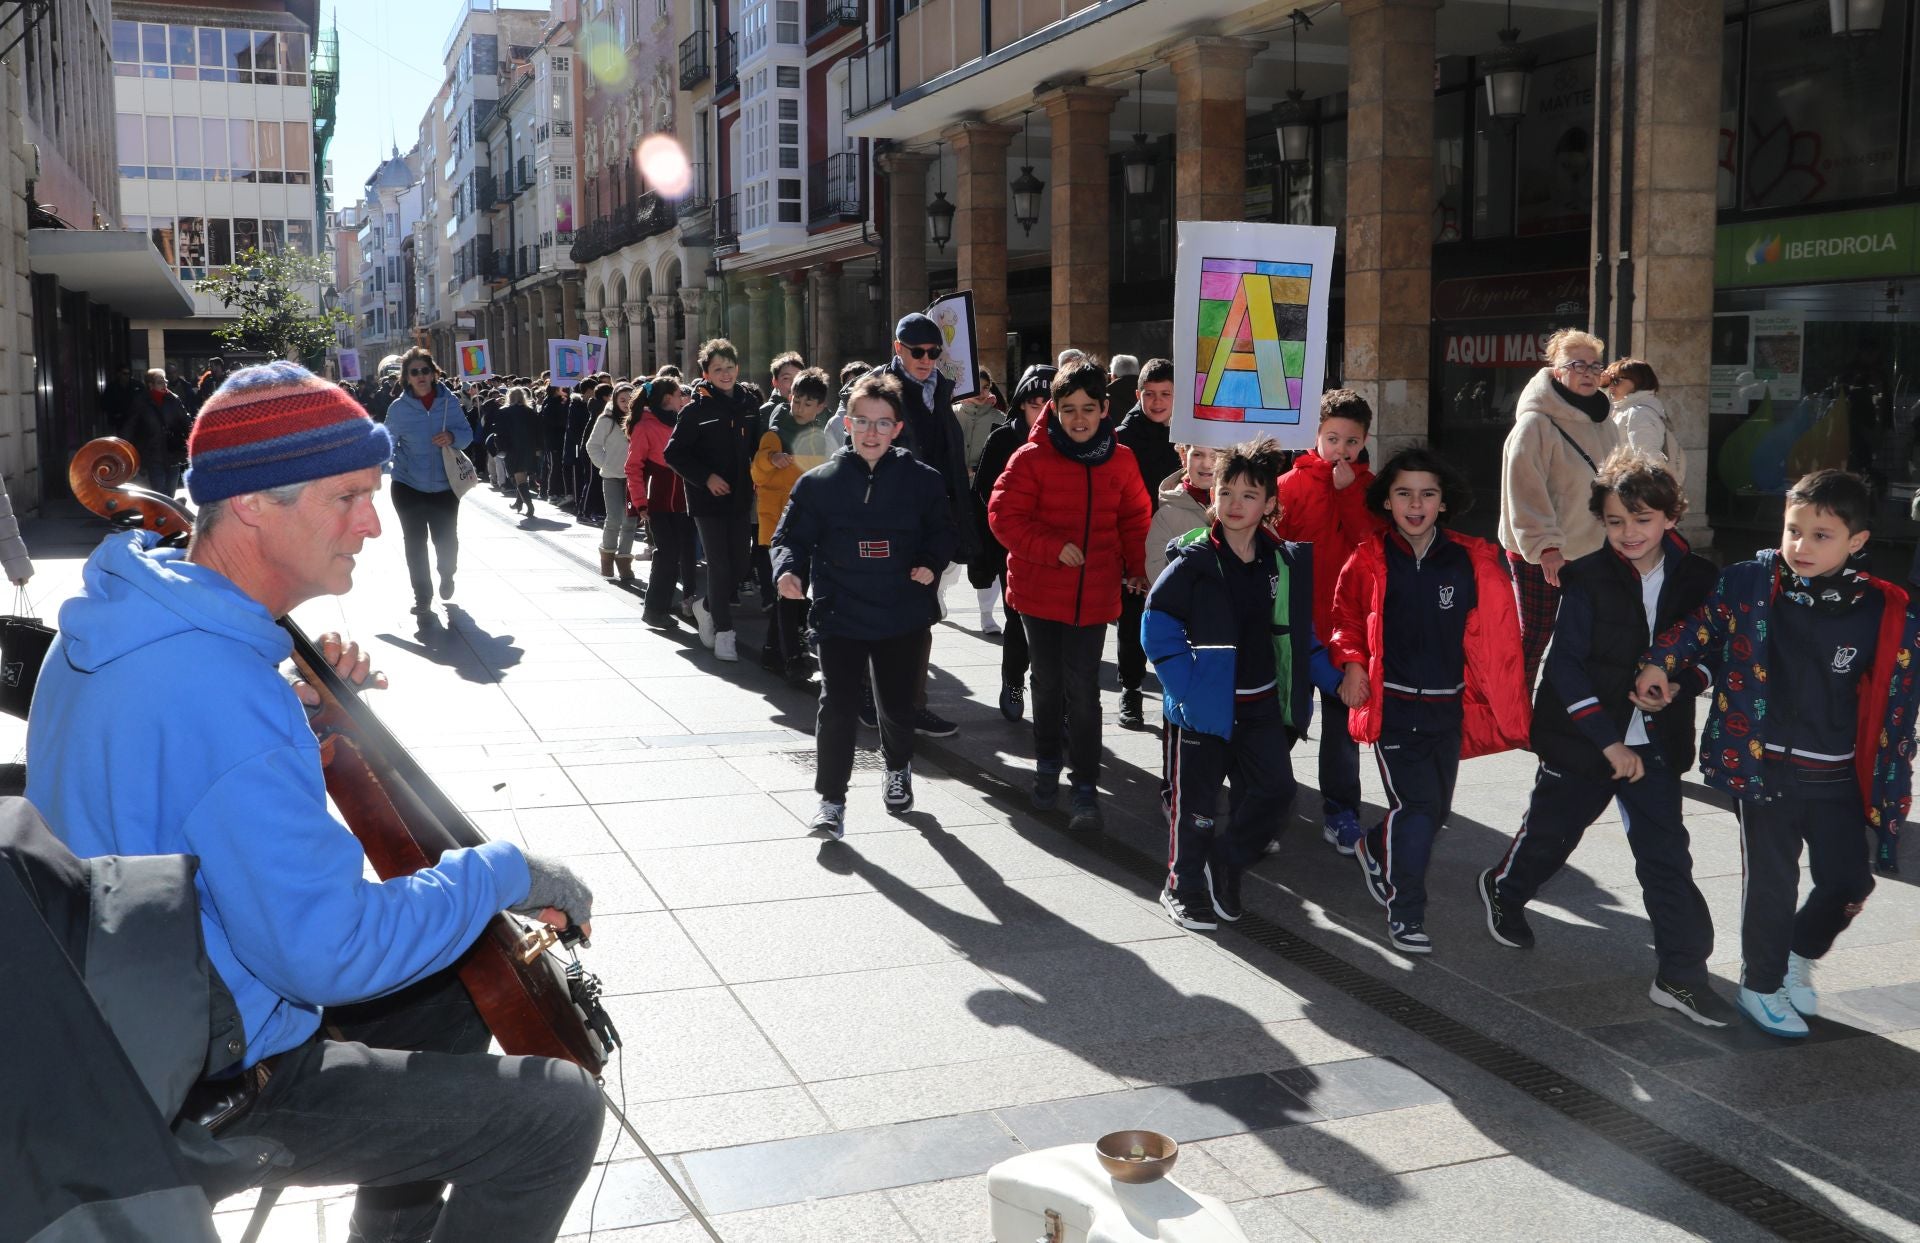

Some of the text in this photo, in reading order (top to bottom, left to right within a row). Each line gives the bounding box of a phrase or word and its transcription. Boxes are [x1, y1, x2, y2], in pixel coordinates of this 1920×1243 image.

[1784, 232, 1897, 260] IBERDROLA
[1200, 273, 1291, 410] A
[1446, 334, 1497, 364] AQUI
